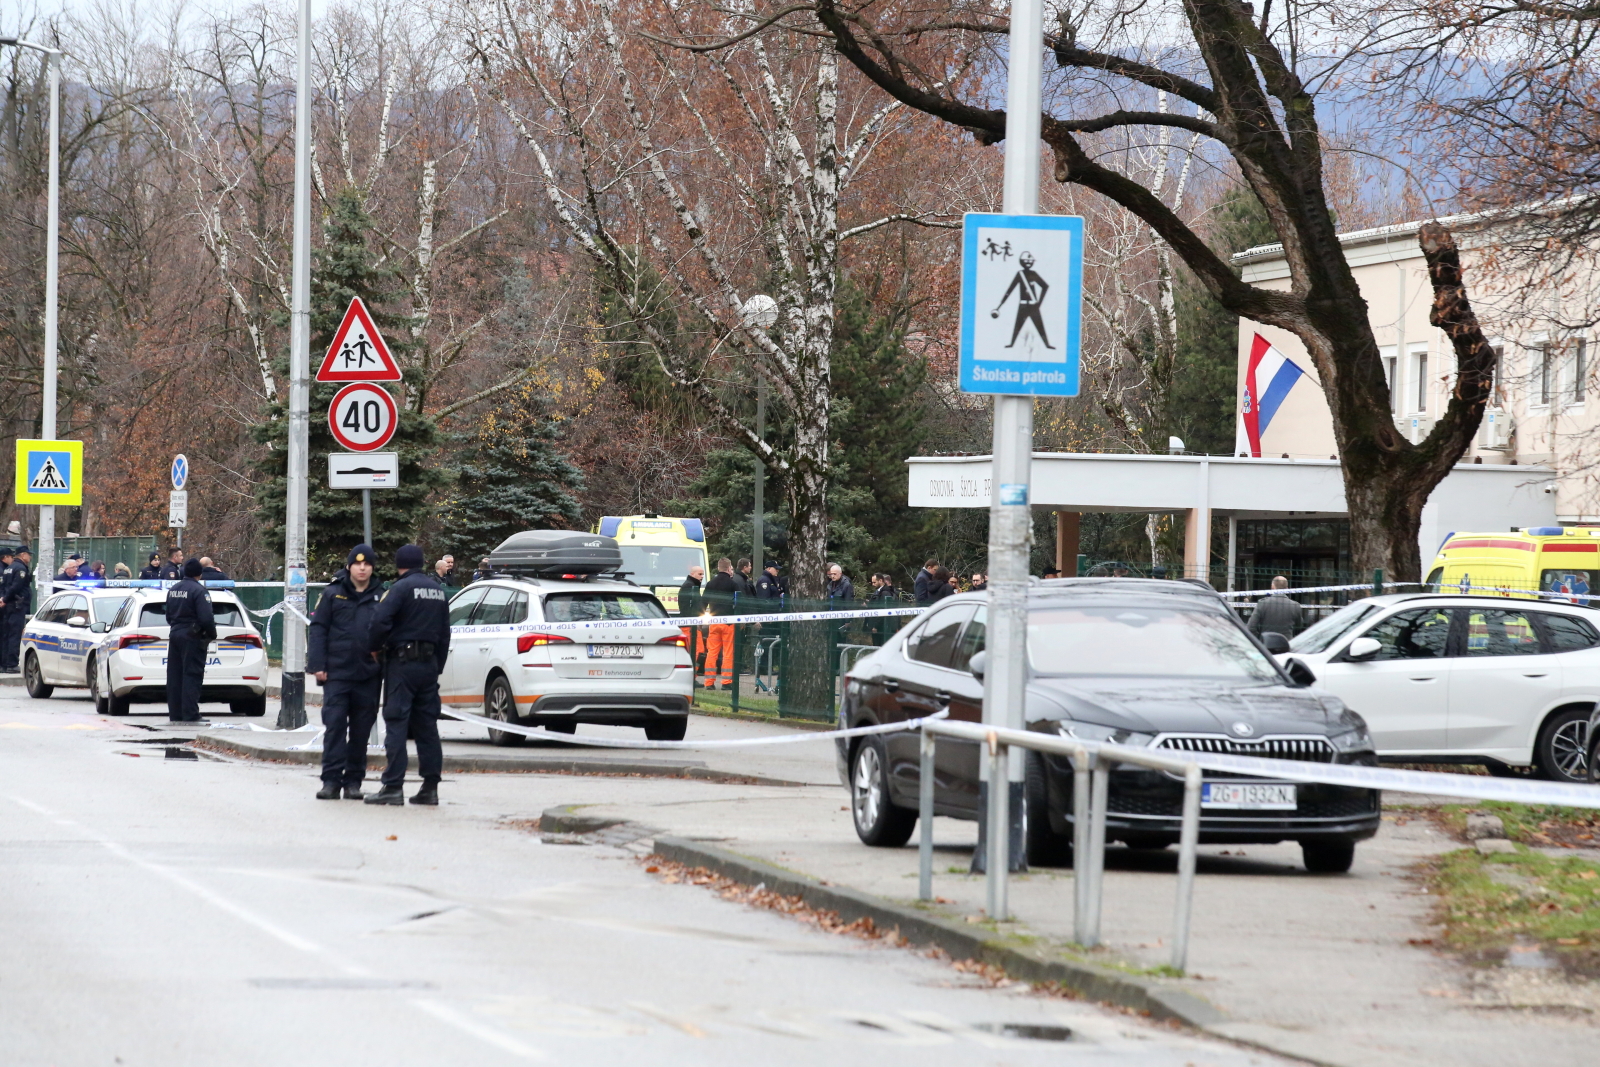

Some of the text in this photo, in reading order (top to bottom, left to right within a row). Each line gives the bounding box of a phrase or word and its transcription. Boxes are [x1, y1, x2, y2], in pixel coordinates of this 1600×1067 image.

[972, 365, 1066, 384] Školska patrola
[342, 400, 380, 433] 40
[930, 480, 954, 497] OSNOVNA
[984, 478, 992, 496] PR
[413, 588, 446, 602] POLICIJA
